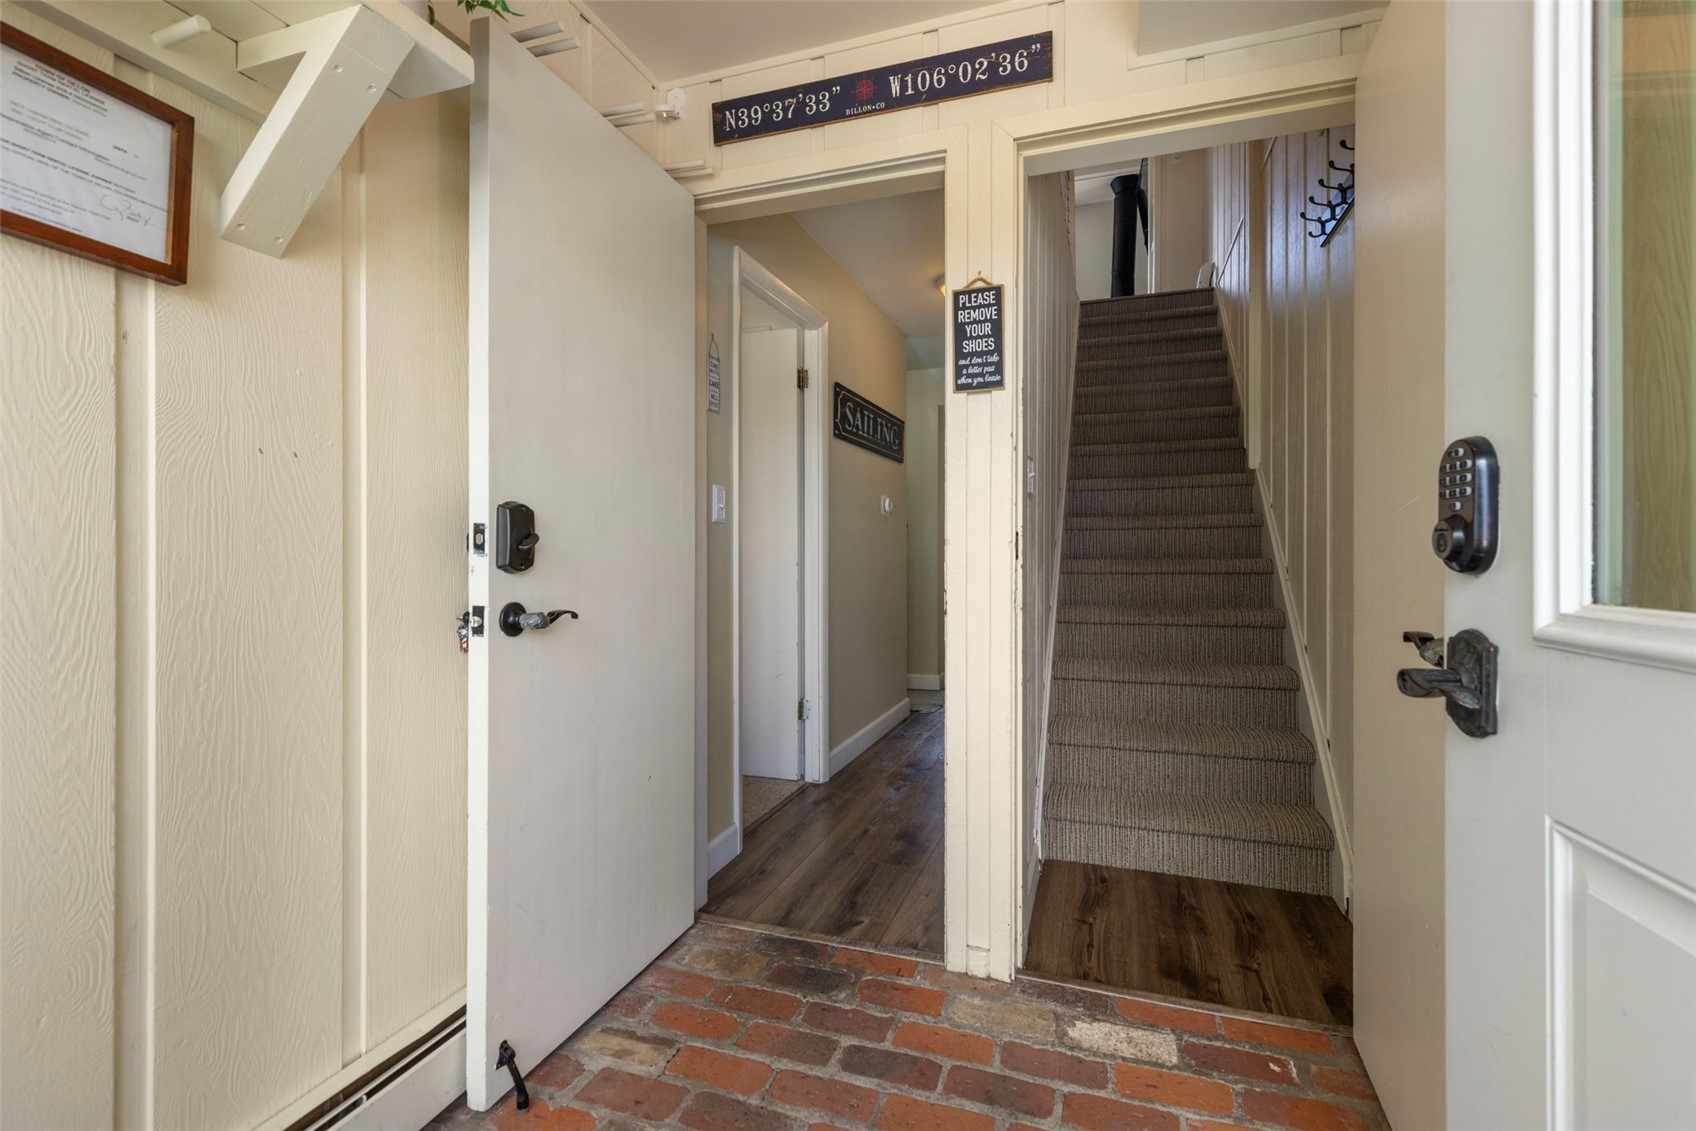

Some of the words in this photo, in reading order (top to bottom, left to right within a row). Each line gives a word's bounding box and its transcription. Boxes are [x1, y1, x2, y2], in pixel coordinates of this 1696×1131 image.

[959, 291, 996, 307] PLEASE
[958, 306, 998, 323] REMOVE
[965, 322, 992, 337] YOUR
[962, 338, 995, 353] SHOES
[958, 357, 970, 365] and
[987, 353, 1000, 362] take
[968, 366, 983, 374] better
[983, 365, 996, 373] pair
[957, 376, 972, 385] when
[973, 378, 984, 386] you
[845, 402, 899, 449] SAILING
